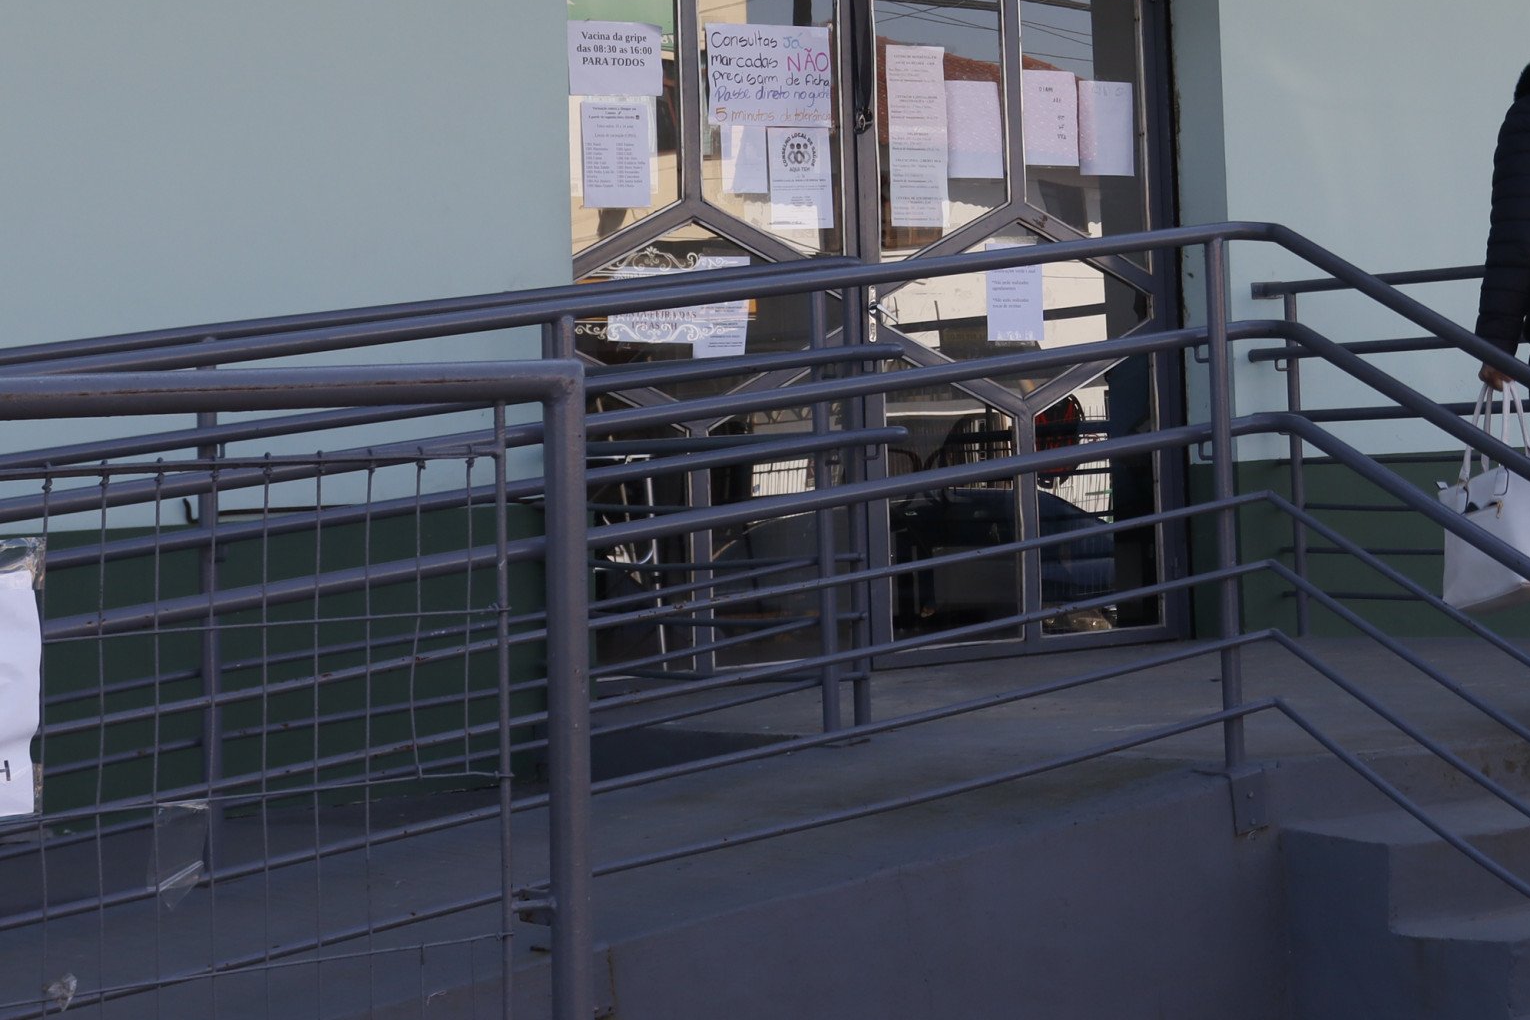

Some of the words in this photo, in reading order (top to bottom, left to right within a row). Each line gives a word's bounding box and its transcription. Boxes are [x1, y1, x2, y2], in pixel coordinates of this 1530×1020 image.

[581, 31, 610, 41] Vacina
[612, 32, 623, 41] da
[625, 33, 647, 44] gripe
[710, 30, 778, 49] Consultas
[576, 44, 591, 53] das
[593, 44, 617, 54] 08:30
[630, 46, 652, 55] 16:00
[582, 56, 609, 66] PARA
[611, 57, 645, 67] TODOS
[711, 52, 778, 68] marcadas
[787, 47, 829, 72] NÃO
[712, 70, 779, 87] precisam
[785, 72, 800, 86] de
[805, 73, 830, 87] ficha
[755, 85, 790, 100] direto
[793, 90, 807, 100] no
[715, 107, 728, 122] 5
